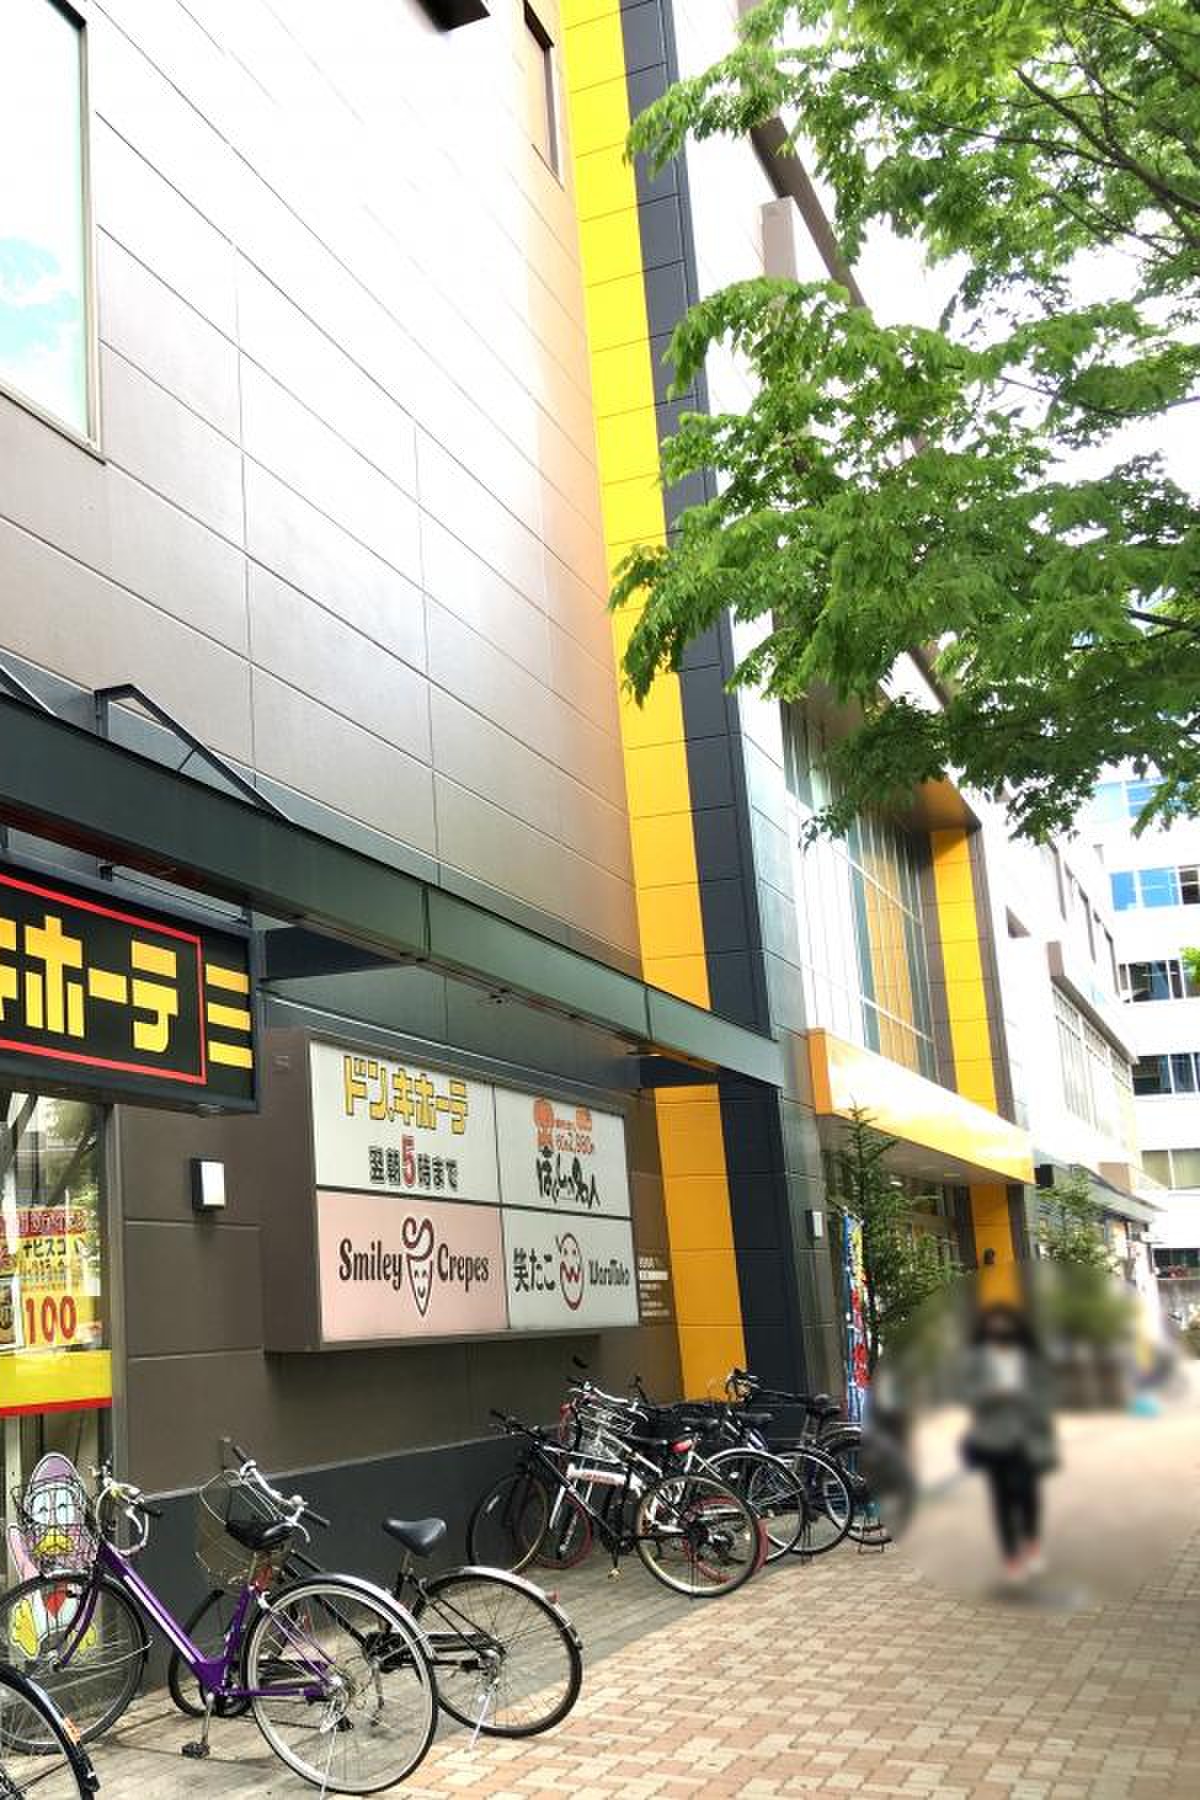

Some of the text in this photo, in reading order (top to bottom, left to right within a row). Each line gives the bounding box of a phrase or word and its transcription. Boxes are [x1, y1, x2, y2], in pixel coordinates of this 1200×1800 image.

[339, 1238, 489, 1292] Smiley Crepes
[513, 1247, 557, 1292] 笑たこ
[25, 1295, 77, 1344] 100
